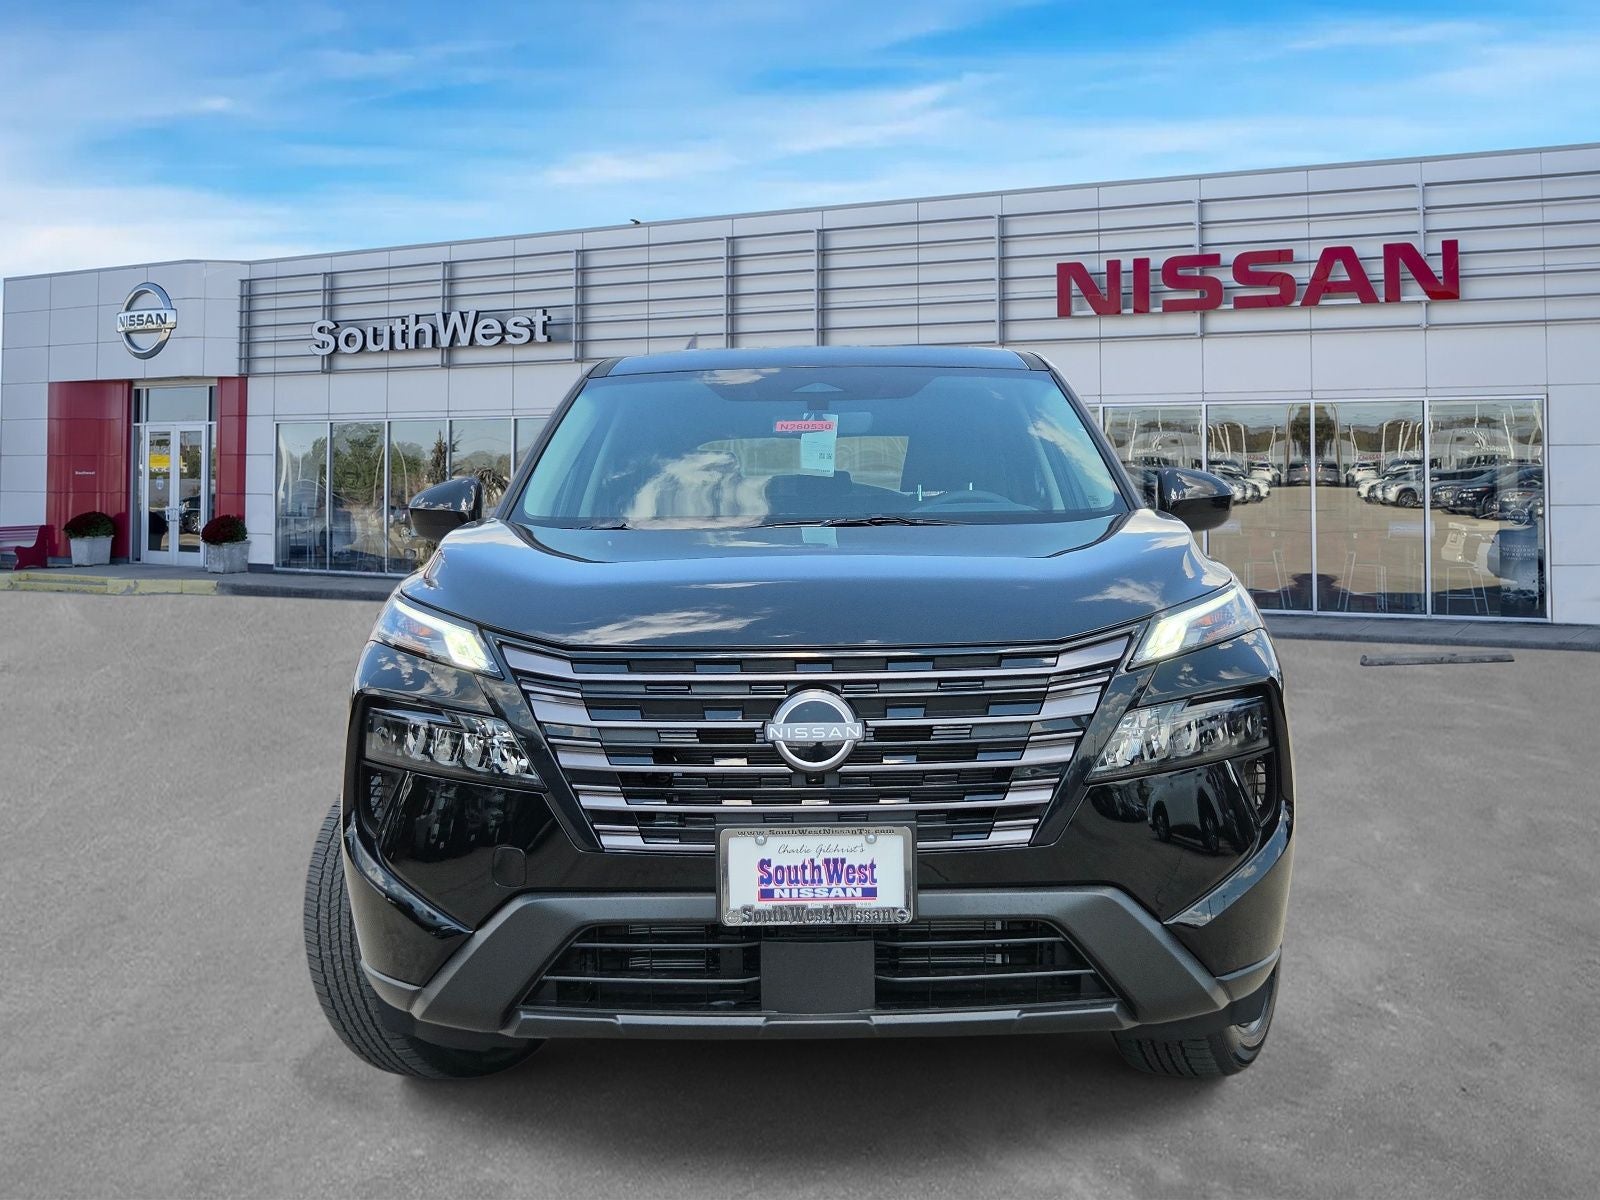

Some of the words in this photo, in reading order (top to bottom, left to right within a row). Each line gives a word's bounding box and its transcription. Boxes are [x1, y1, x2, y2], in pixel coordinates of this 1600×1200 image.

[1056, 239, 1461, 318] NISSAN
[119, 312, 167, 328] NISSAN
[310, 309, 551, 356] SouthWest
[769, 726, 860, 738] NISSAN
[777, 843, 812, 855] Charlie
[757, 857, 878, 886] SouthWest
[773, 887, 862, 899] NISSAN
